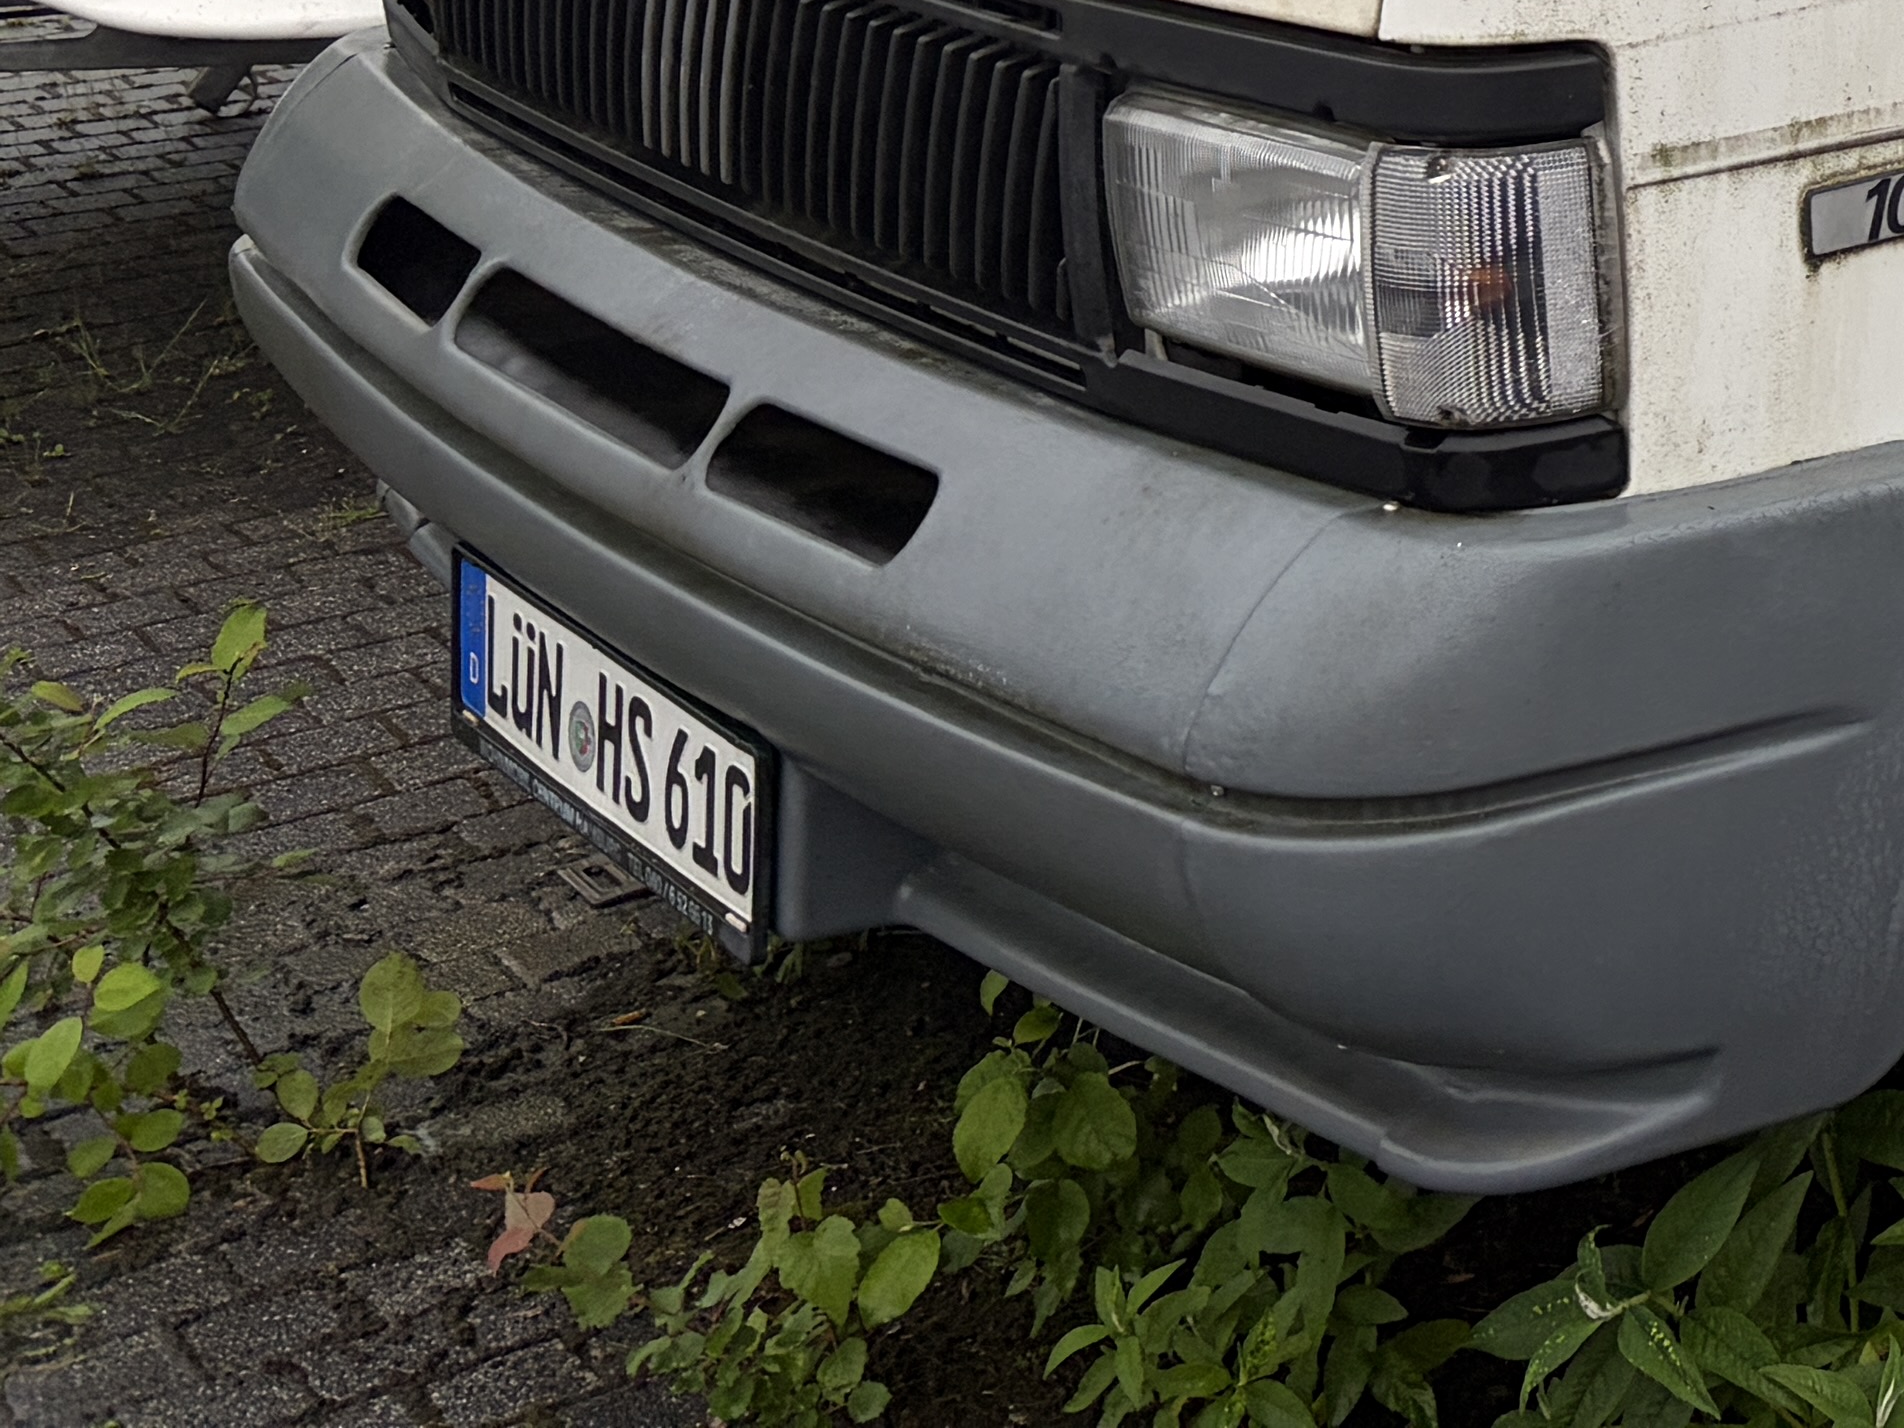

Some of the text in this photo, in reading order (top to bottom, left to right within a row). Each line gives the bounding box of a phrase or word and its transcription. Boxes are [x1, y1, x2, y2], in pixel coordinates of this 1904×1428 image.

[469, 651, 479, 685] D
[597, 671, 653, 823] HS
[665, 728, 752, 896] 610
